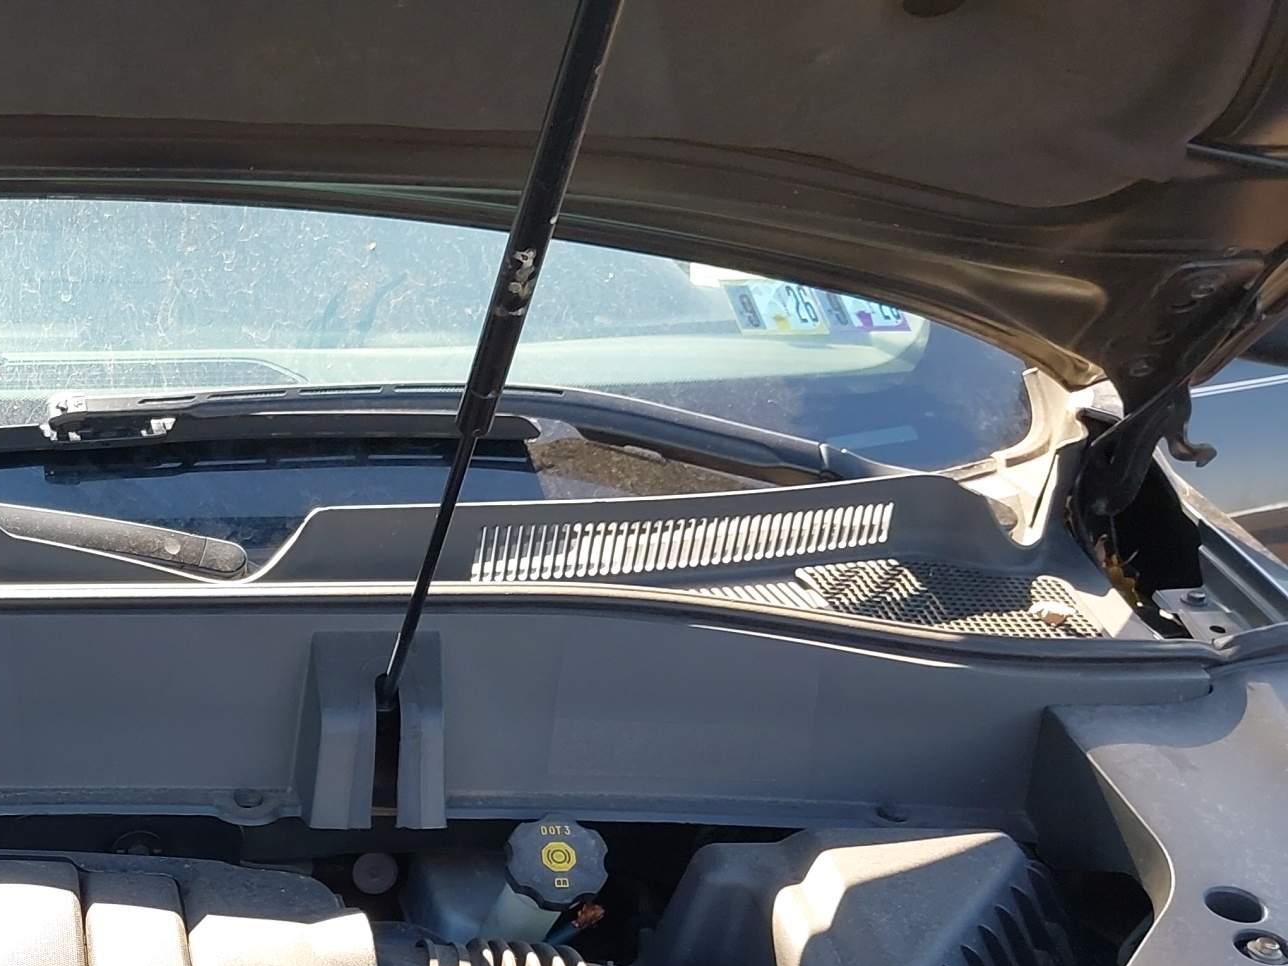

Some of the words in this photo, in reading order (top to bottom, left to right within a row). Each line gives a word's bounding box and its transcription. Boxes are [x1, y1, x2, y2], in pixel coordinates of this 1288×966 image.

[785, 284, 819, 324] 26
[540, 825, 561, 836] DOT
[564, 825, 571, 836] 3
